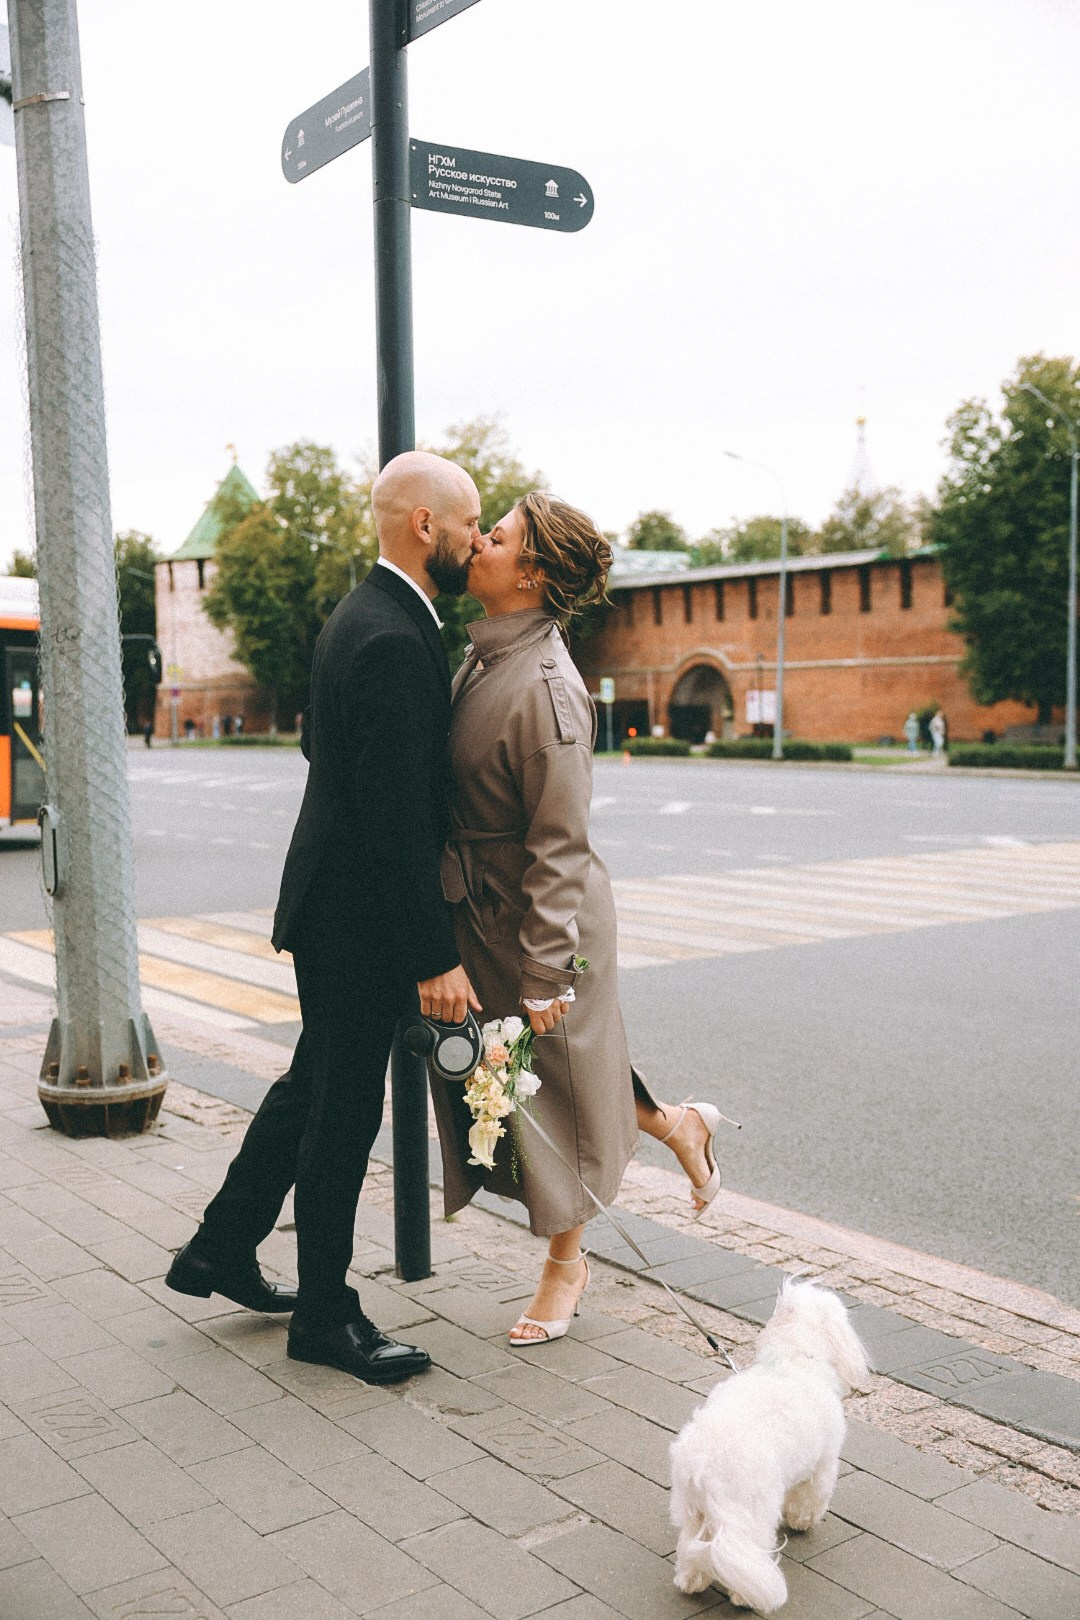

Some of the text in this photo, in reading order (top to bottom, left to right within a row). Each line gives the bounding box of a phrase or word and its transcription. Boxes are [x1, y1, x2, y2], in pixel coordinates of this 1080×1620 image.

[428, 154, 456, 168] НГХМ
[428, 164, 518, 189] Русское искусство
[428, 180, 502, 199] Nizhny Novgorod State
[428, 189, 440, 199] Art
[440, 192, 469, 203] Museum
[472, 197, 498, 208] Russian
[498, 201, 510, 210] Art
[914, 1354, 1013, 1390] 1221
